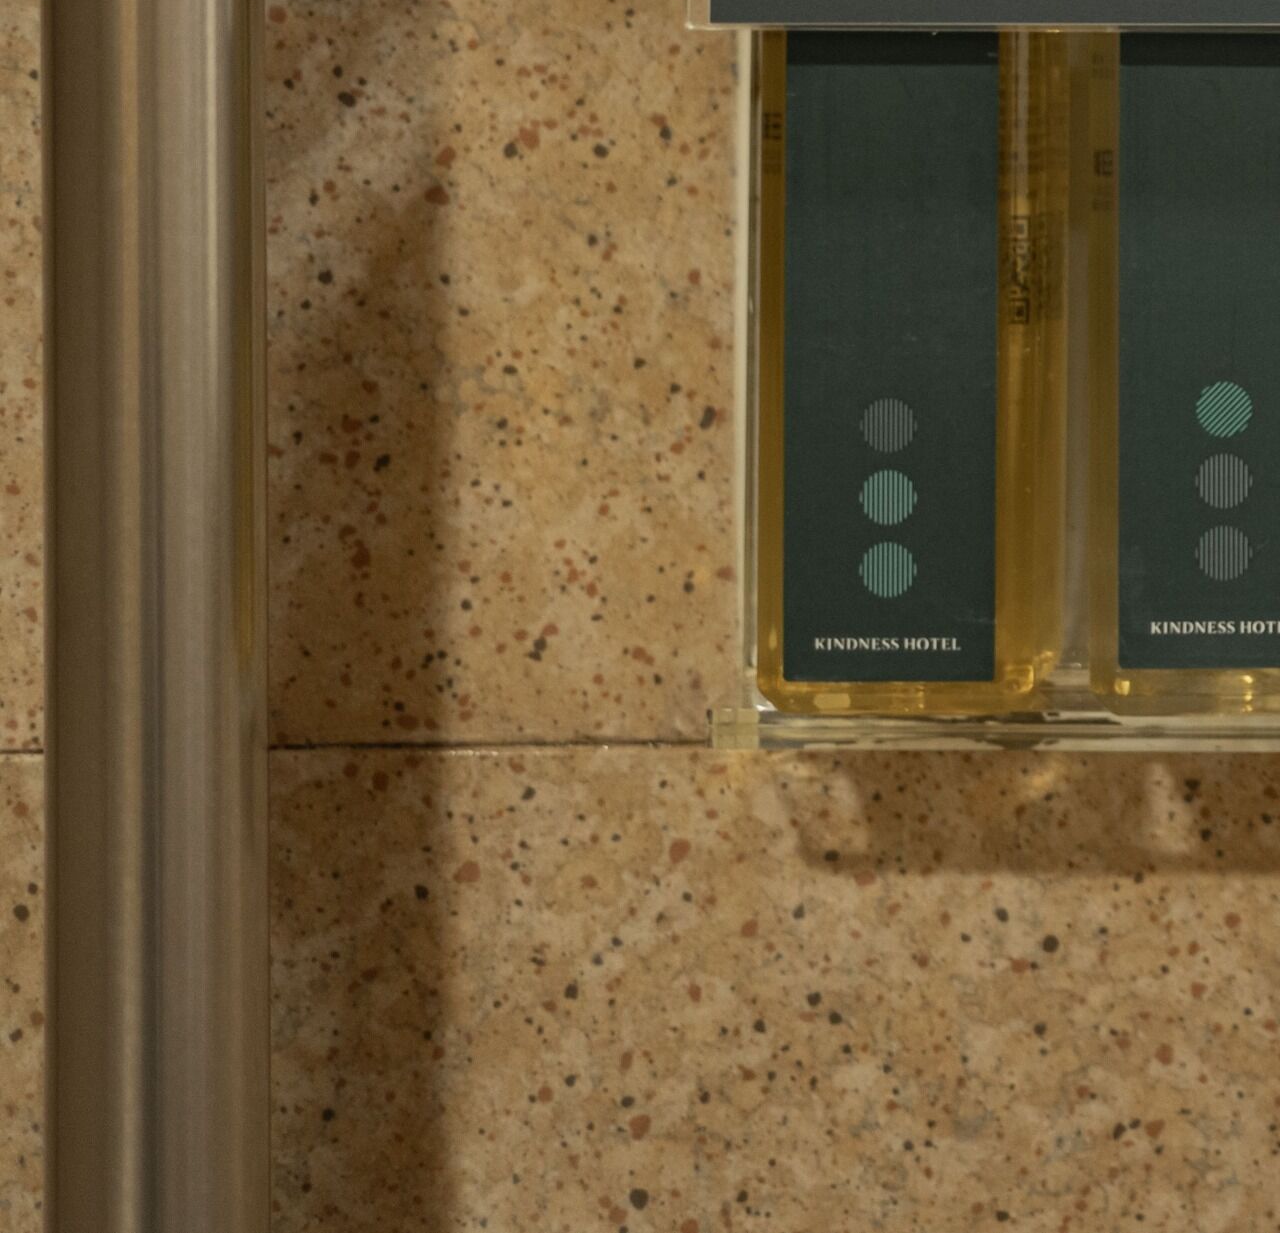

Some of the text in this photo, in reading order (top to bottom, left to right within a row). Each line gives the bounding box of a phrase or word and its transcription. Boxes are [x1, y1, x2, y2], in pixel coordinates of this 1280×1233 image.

[1150, 620, 1236, 636] KINDNESS
[814, 637, 961, 652] KINDNESS HOTEL
